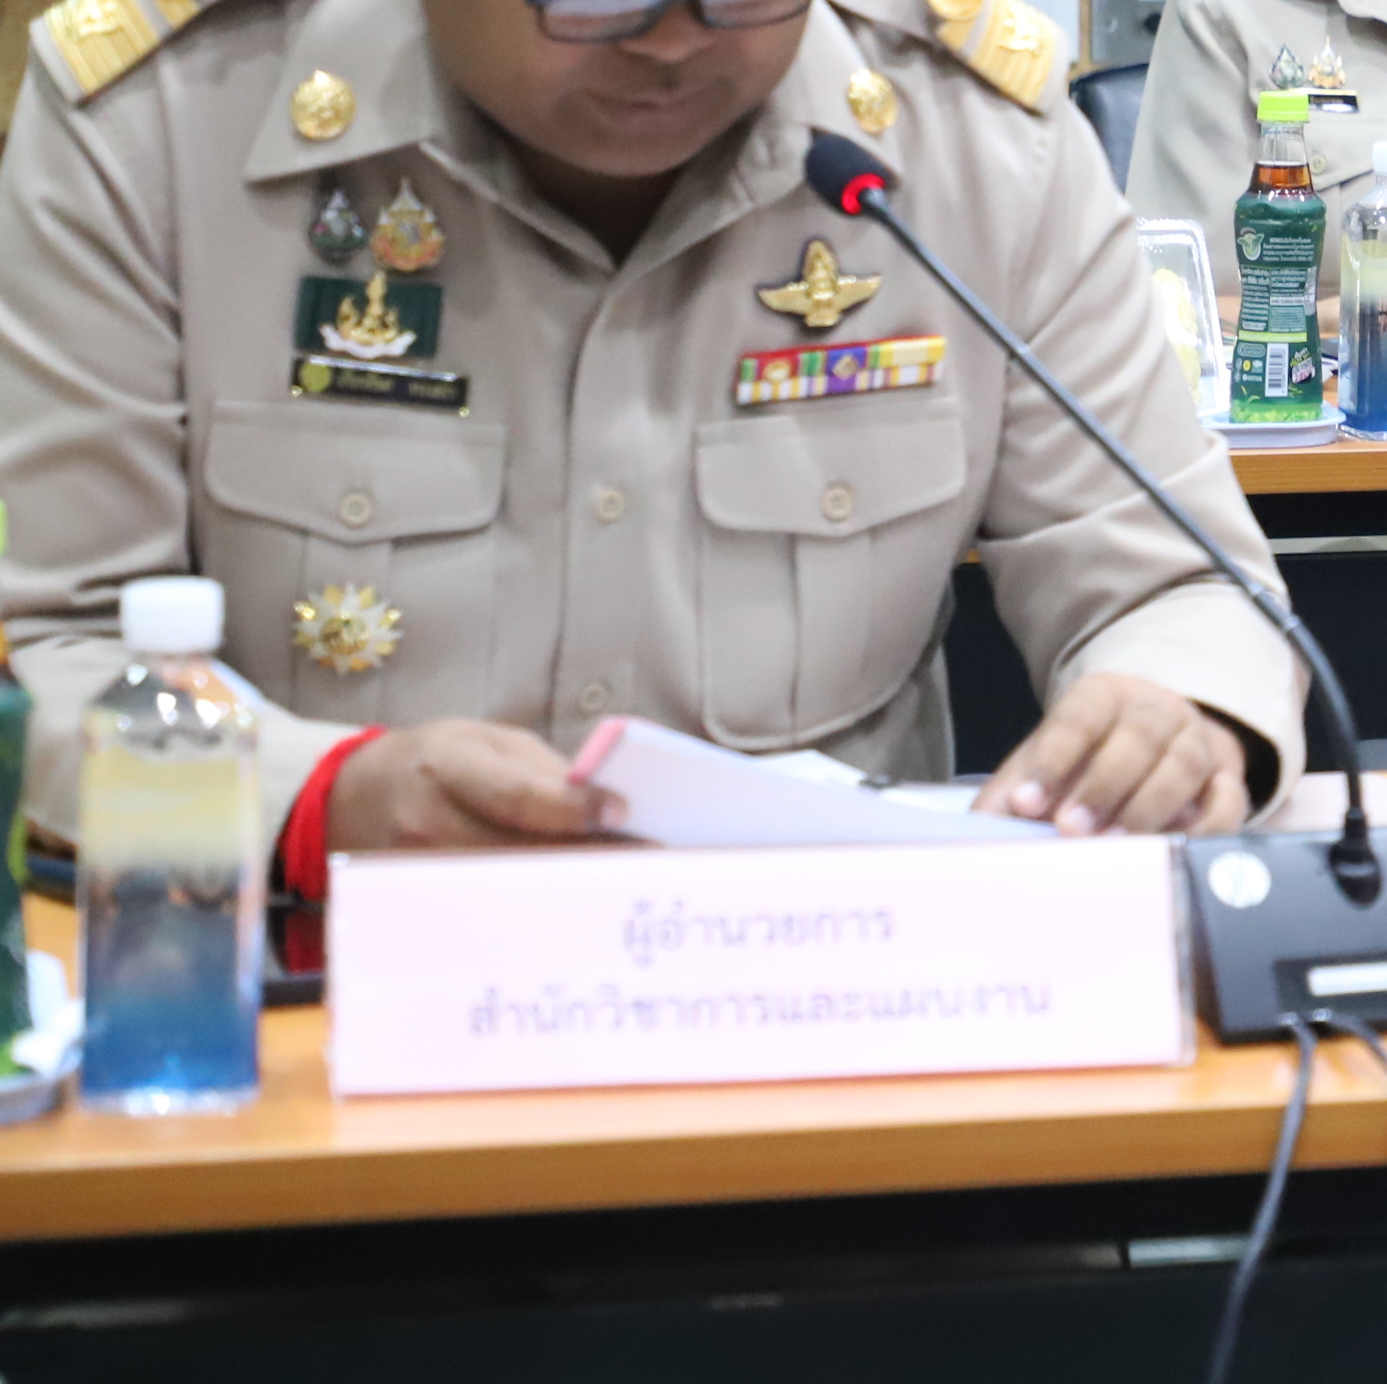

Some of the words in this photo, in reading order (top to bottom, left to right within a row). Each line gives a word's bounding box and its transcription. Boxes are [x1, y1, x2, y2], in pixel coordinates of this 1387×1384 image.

[620, 899, 898, 968] ผู้อำนวยการ
[467, 982, 1054, 1038] สำนักวิชาการและแผนงาน
